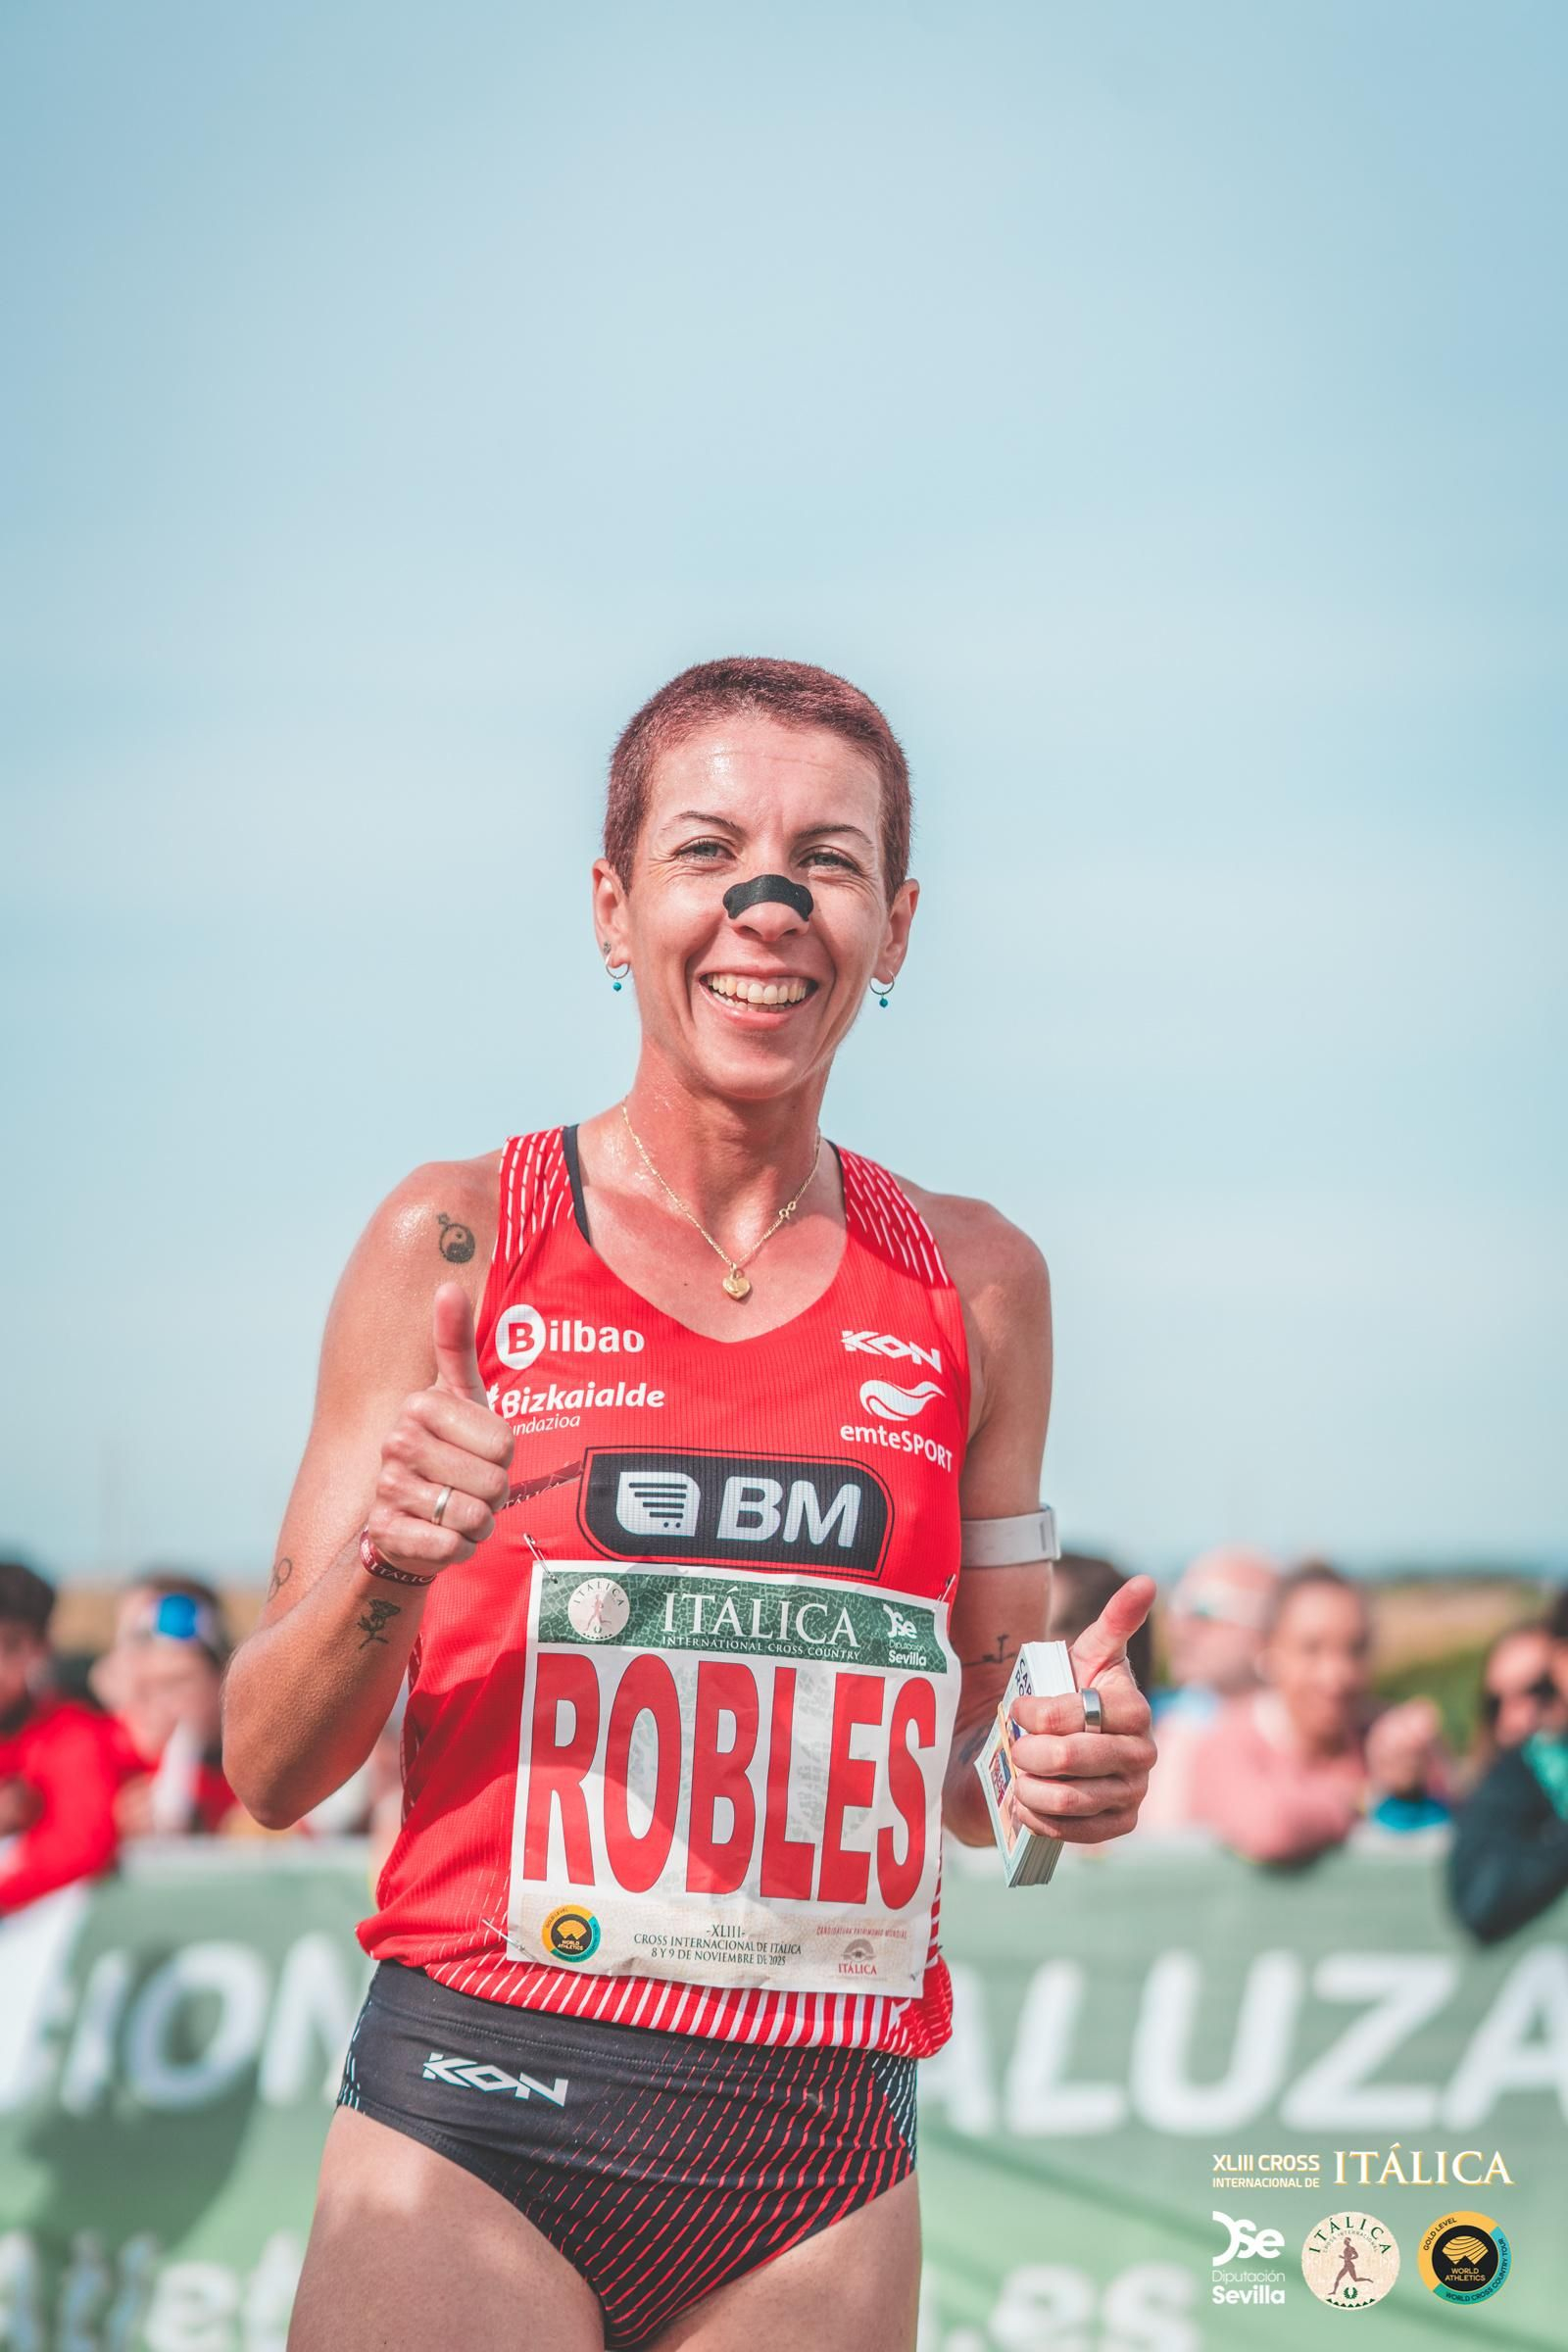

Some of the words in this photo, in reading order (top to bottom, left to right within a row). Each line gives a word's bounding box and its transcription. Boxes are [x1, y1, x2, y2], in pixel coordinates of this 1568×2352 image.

[504, 1318, 645, 1357] Bilbao
[501, 1381, 665, 1419] Bizkaialde
[840, 1424, 953, 1473] emteSPORT
[716, 1475, 861, 1548] BM
[661, 1585, 861, 1648] ITÁLICA
[662, 1636, 763, 1652] INTERNATIONAL
[767, 1642, 804, 1655] CROSS
[808, 1646, 861, 1661] COUNTRY
[888, 1649, 927, 1666] Sevilla
[522, 1651, 938, 1911] ROBLES
[633, 1933, 668, 1946] CROSS
[670, 1936, 755, 1952] INTERNACIONAL
[756, 1942, 768, 1953] DE
[651, 1947, 658, 1958] 8
[660, 1947, 667, 1958] Y
[668, 1948, 675, 1959] 9
[677, 1949, 692, 1961] DE
[694, 1950, 755, 1965] NOVIEMBRE
